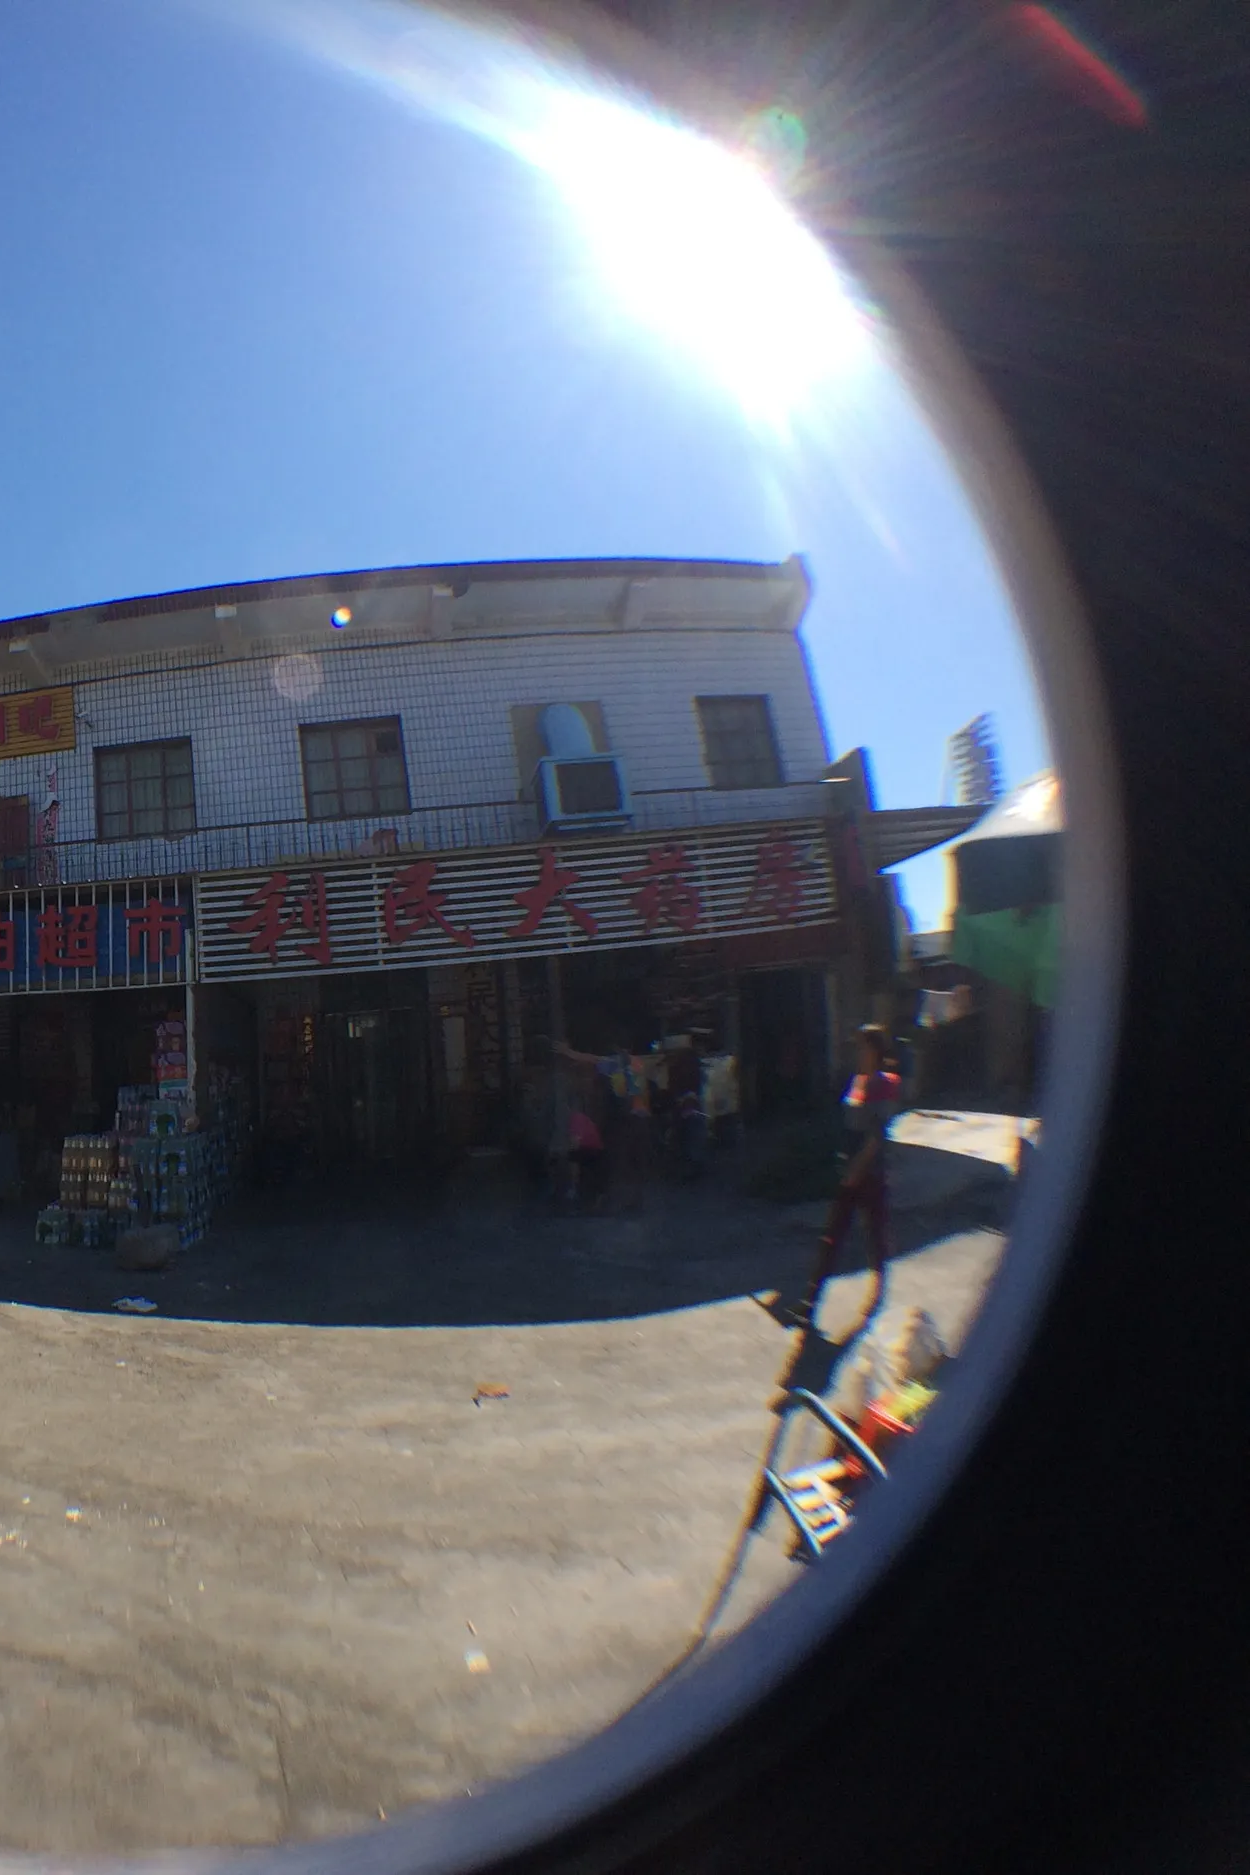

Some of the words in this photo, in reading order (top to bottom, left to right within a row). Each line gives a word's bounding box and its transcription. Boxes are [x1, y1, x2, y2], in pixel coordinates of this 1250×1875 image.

[227, 832, 812, 966] 利民大药房
